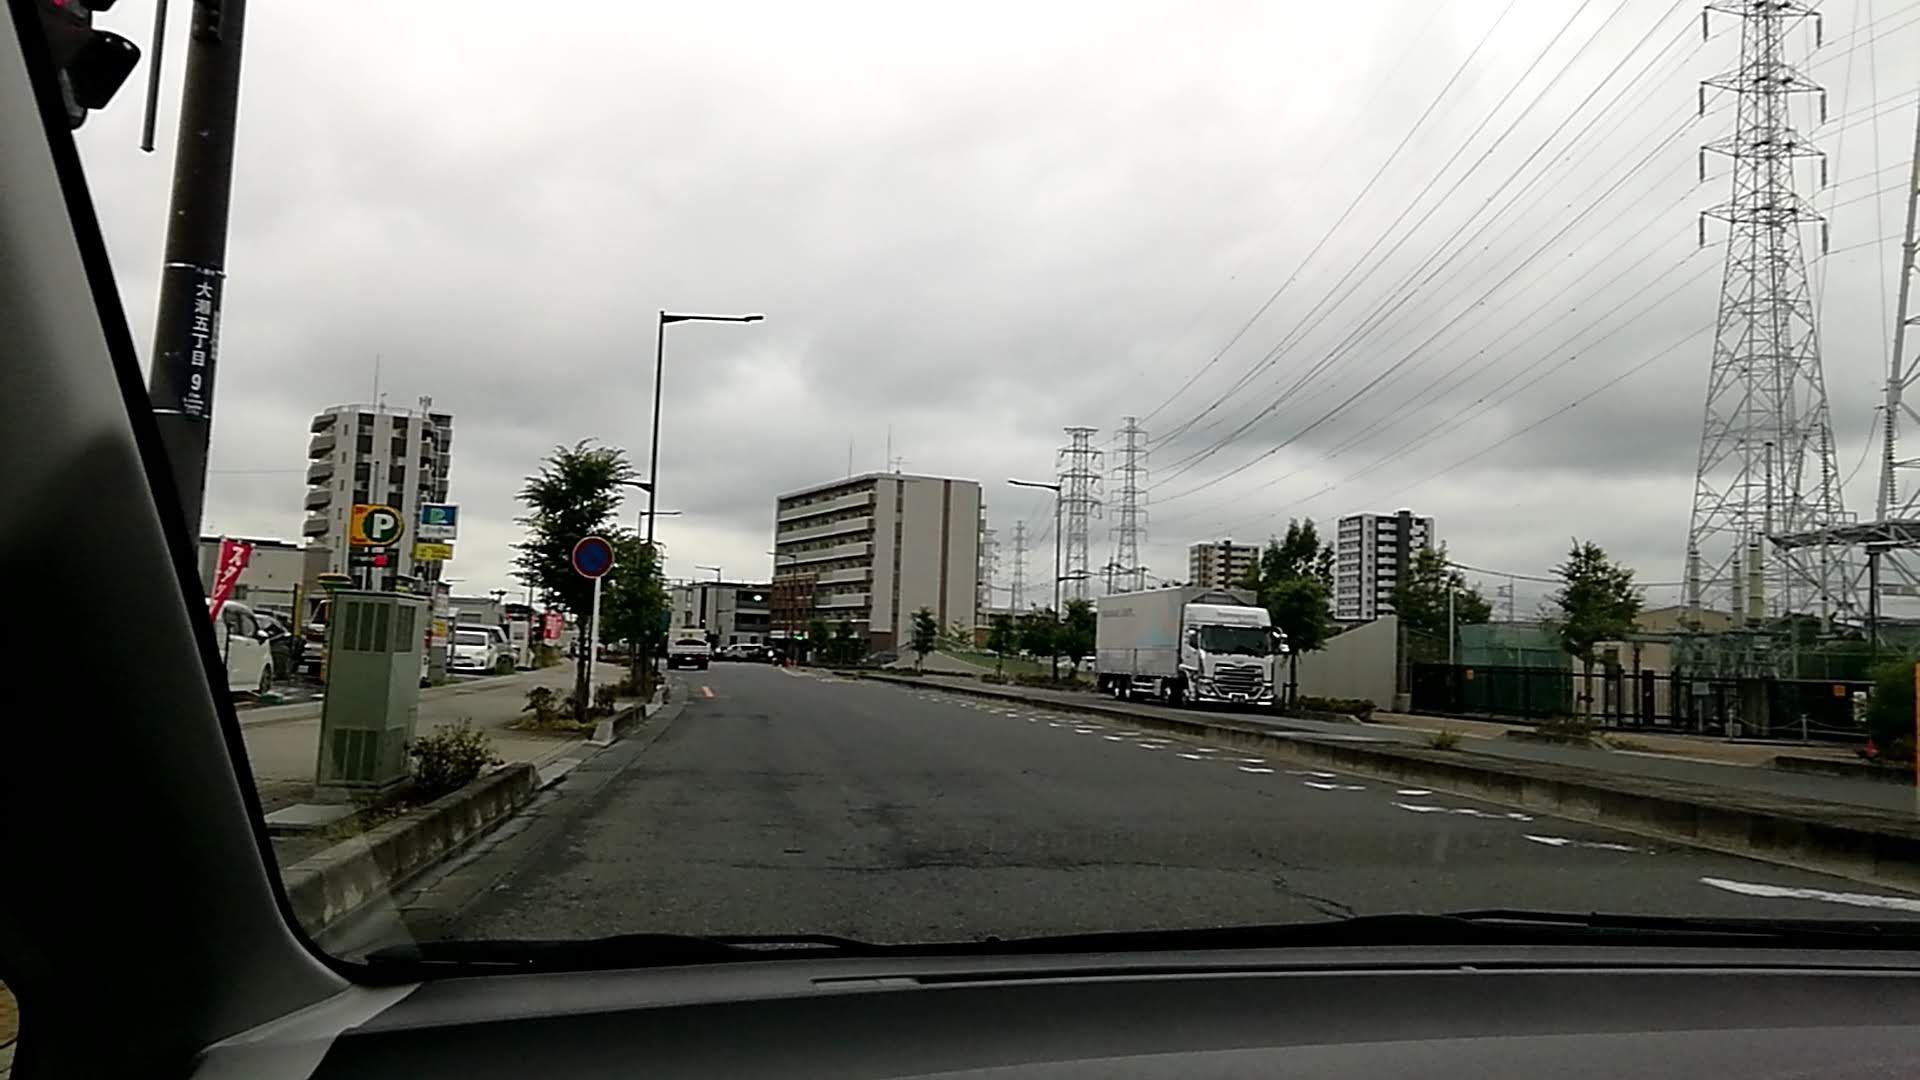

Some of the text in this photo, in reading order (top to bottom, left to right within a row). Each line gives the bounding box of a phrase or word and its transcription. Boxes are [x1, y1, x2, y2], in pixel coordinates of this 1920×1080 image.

[372, 513, 395, 538] P
[209, 546, 245, 614] スタッ
